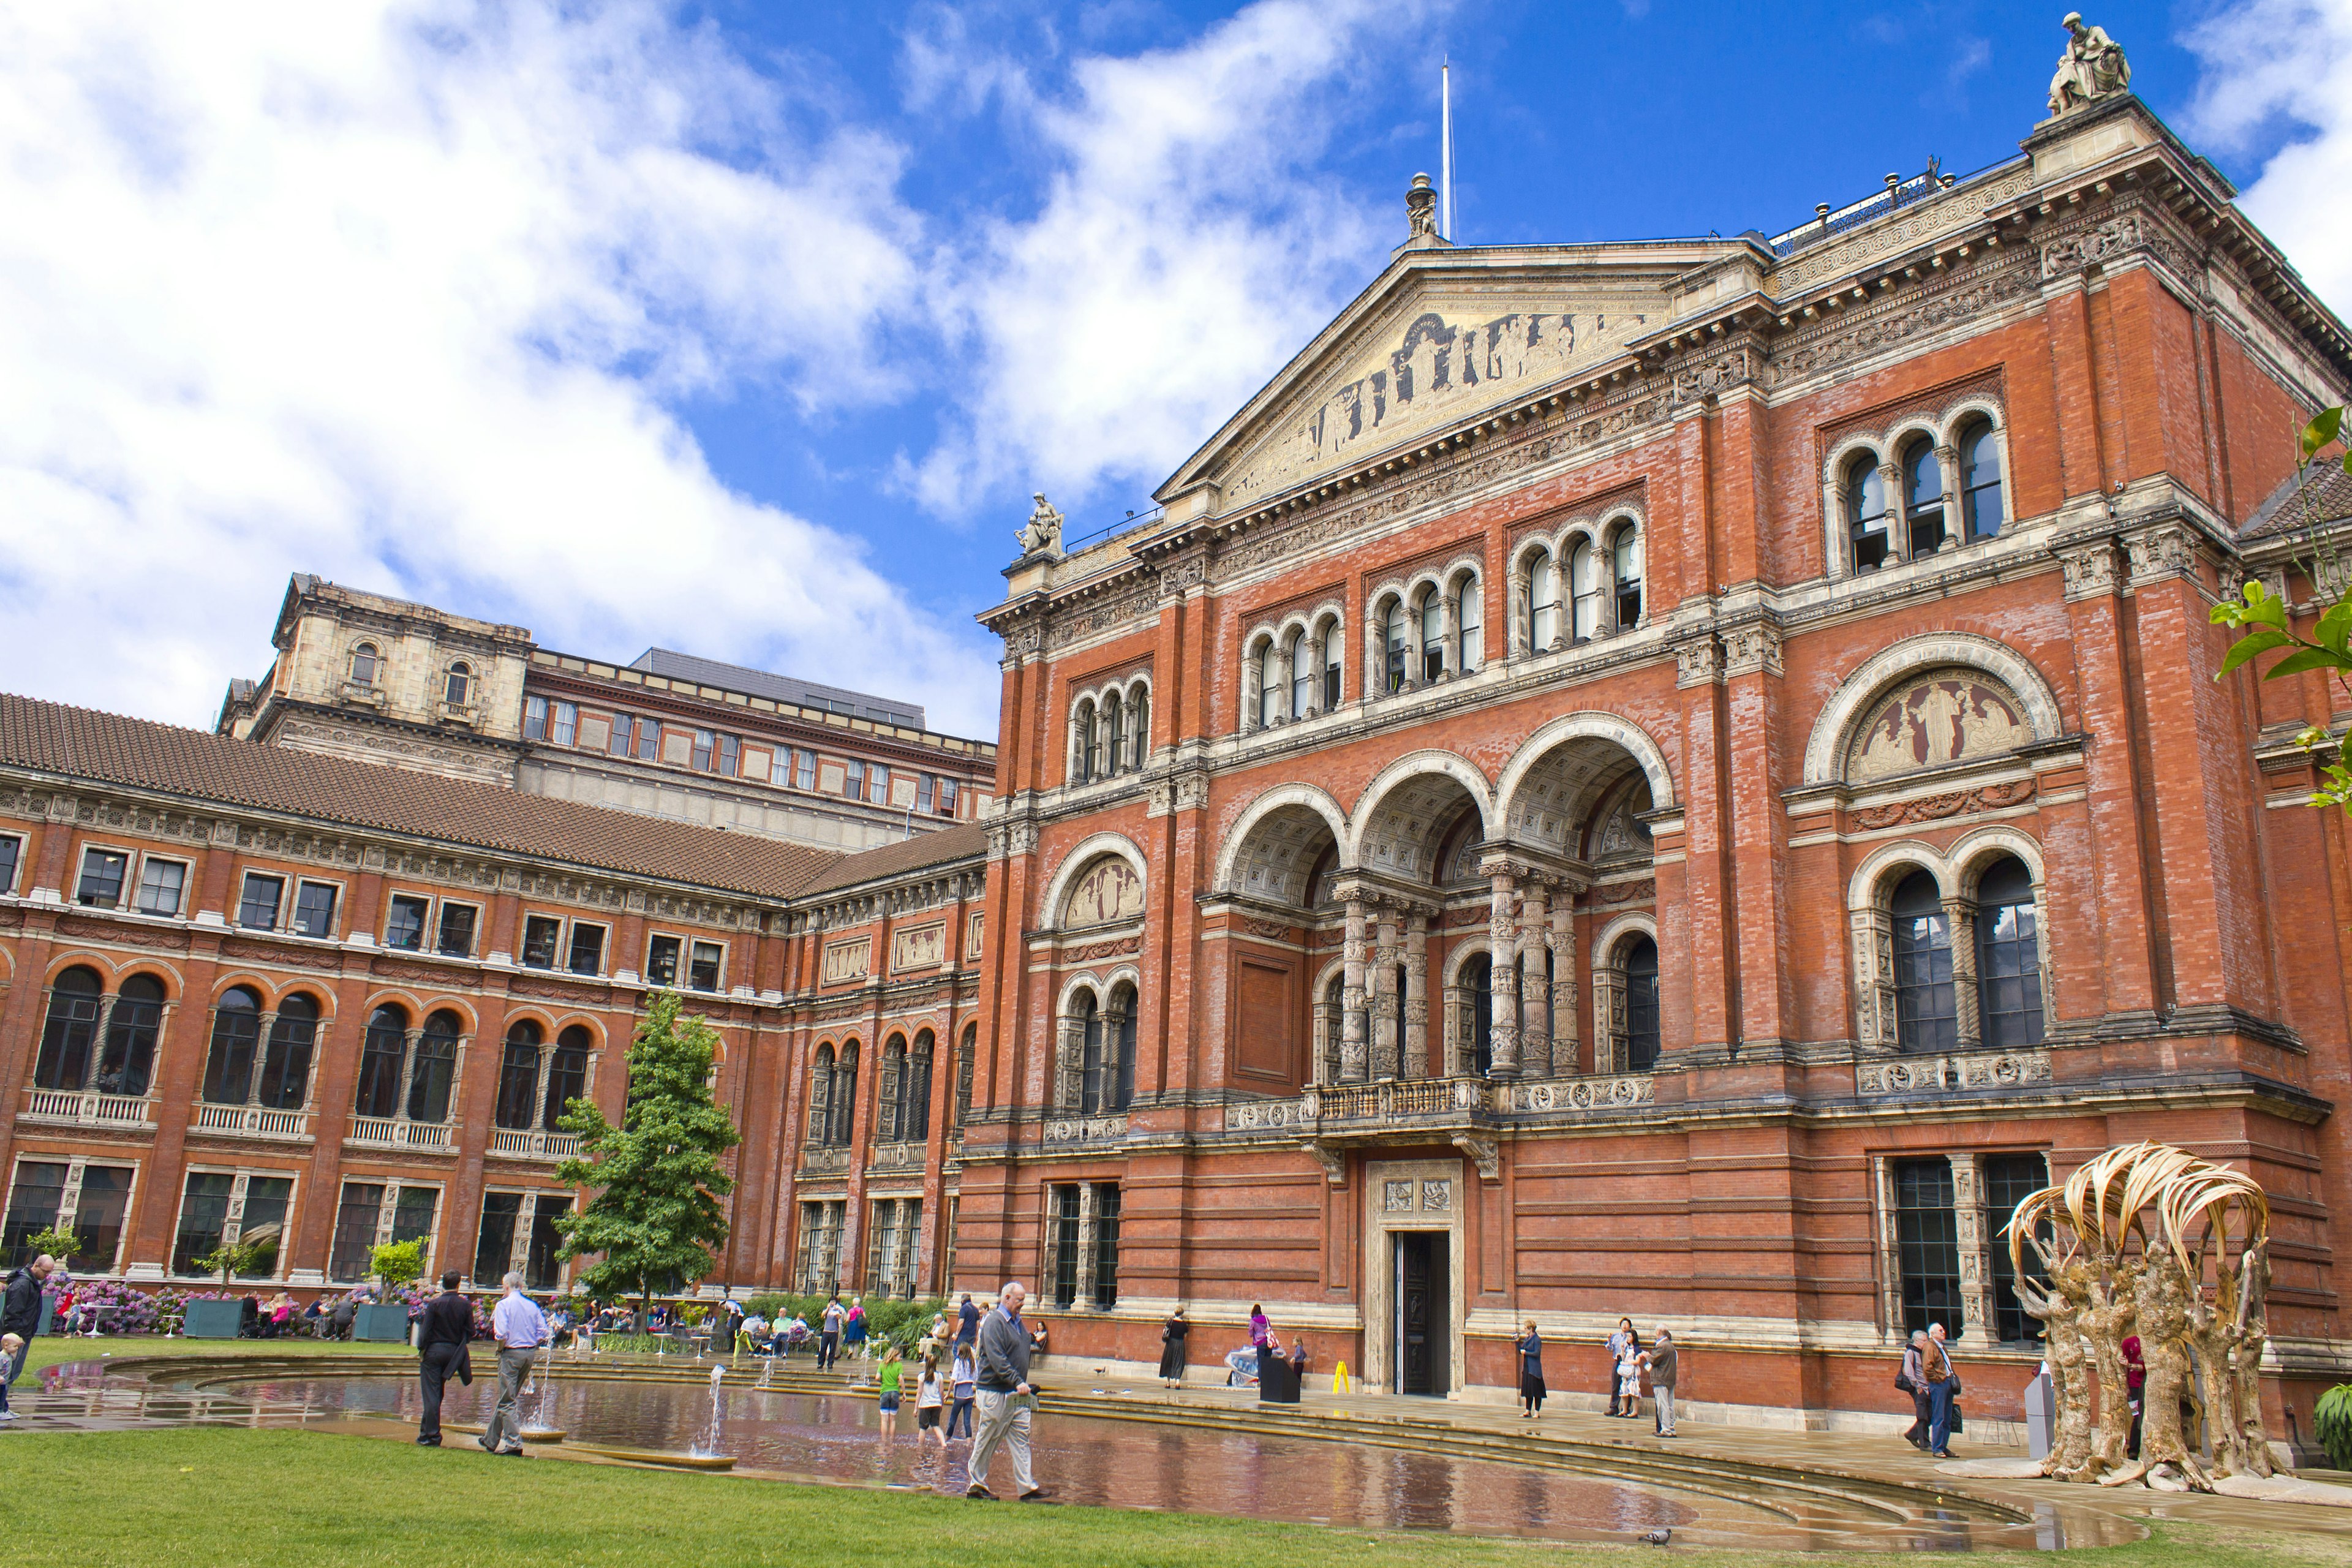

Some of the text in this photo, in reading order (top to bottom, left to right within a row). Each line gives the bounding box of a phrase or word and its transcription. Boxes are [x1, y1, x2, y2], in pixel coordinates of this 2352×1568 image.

[1411, 321, 1436, 337] VICTORIA
[1374, 436, 1392, 445] WORKS
[1404, 420, 1430, 434] INDUSTRY
[1455, 400, 1480, 412] NATIONS
[1488, 390, 1504, 400] ANNO
[1507, 380, 1528, 391] DOMINI
[1253, 451, 1268, 466] INDIA
[1852, 726, 1867, 756] WISDOM
[1867, 698, 1889, 723] COMETH
[1891, 682, 1910, 696] FROM
[1985, 676, 2003, 690] WITH
[2003, 688, 2016, 701] HIM
[2016, 700, 2026, 714] FOR
